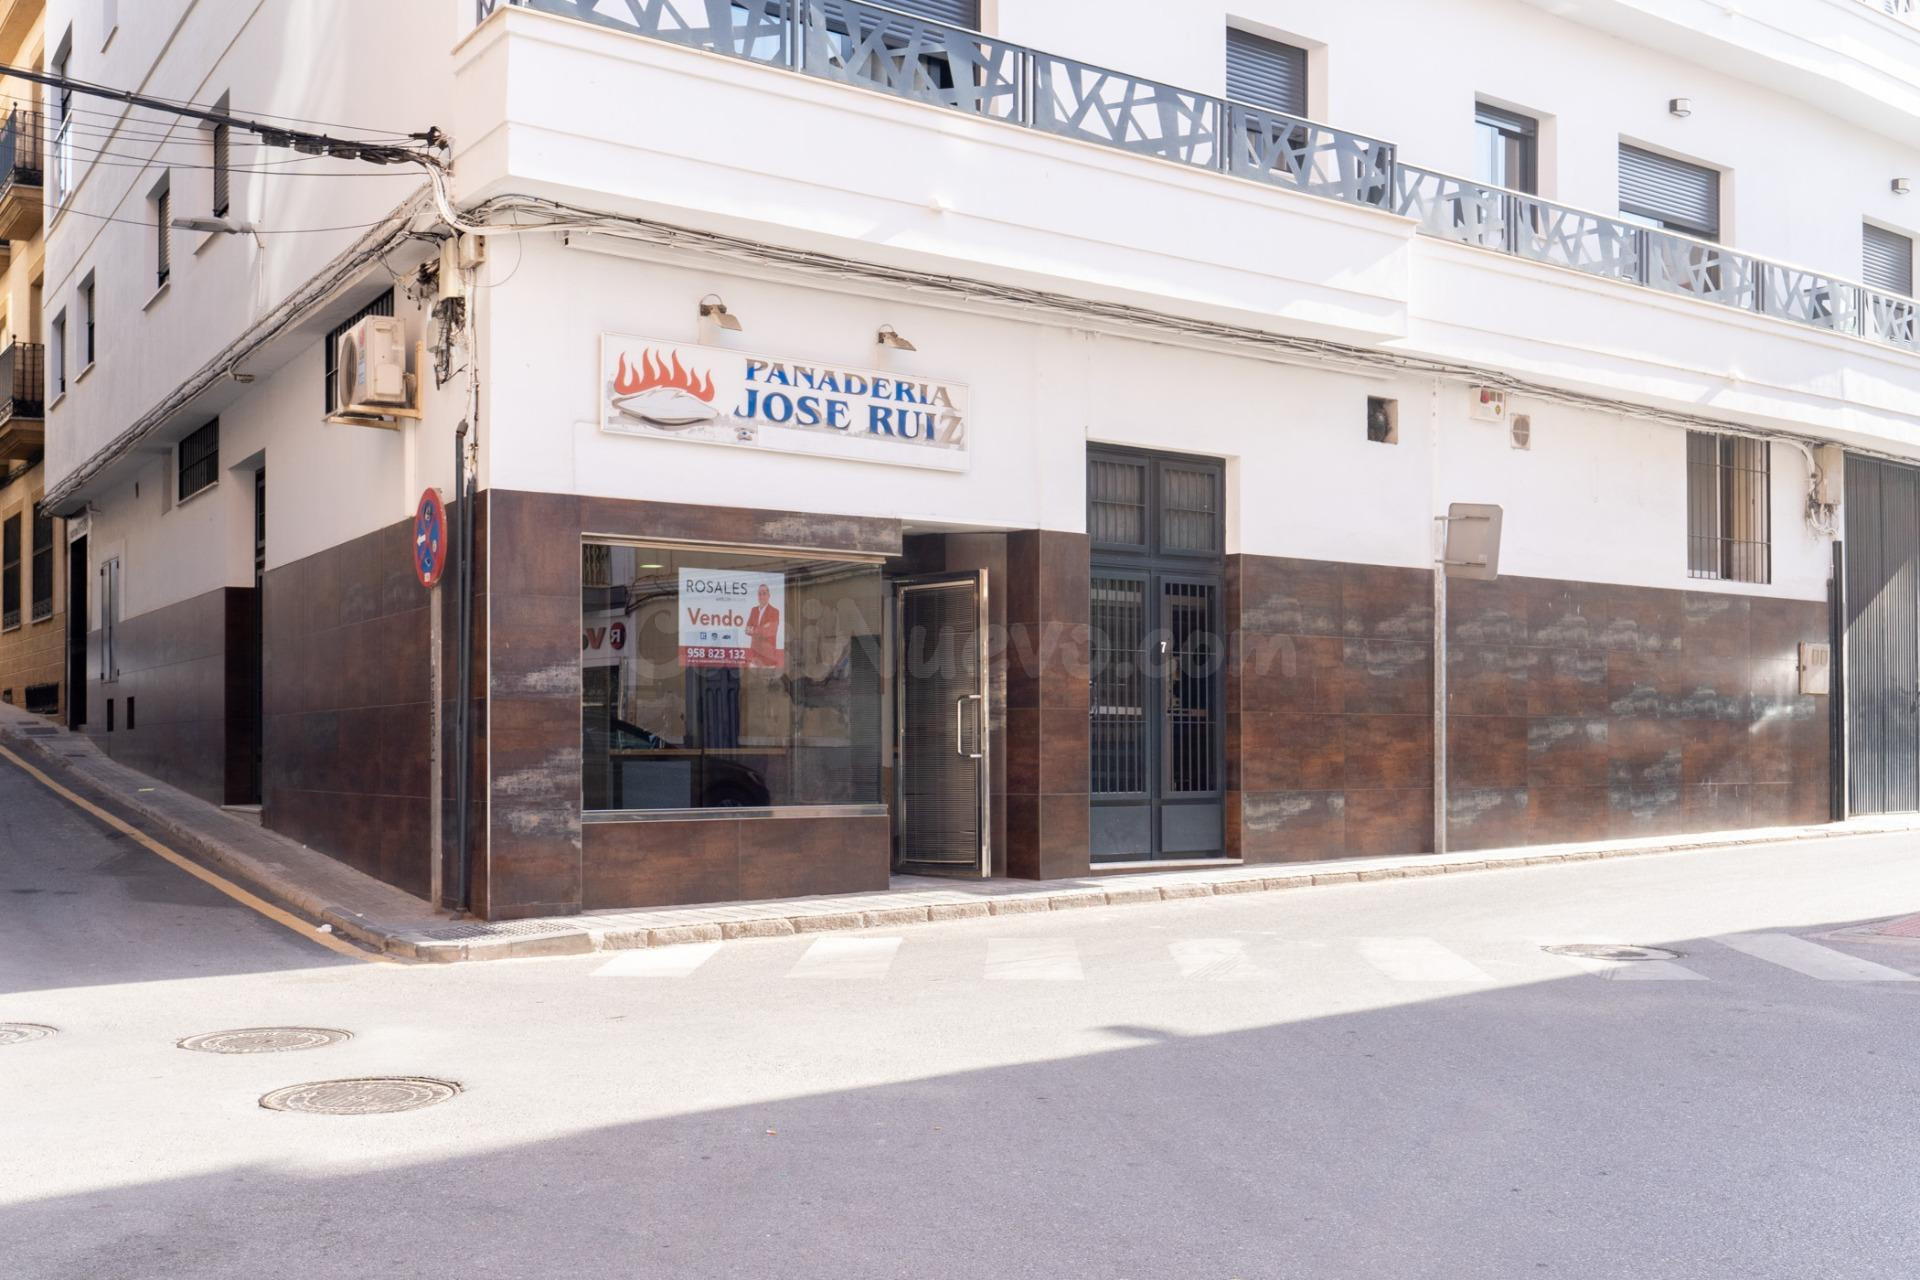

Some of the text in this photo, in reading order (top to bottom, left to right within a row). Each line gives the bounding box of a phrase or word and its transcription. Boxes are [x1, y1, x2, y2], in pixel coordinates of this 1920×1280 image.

[745, 358, 960, 411] PANADERIA
[733, 388, 965, 445] JOSE RUIZ
[686, 579, 748, 595] ROSALES
[687, 607, 744, 627] Vendo
[687, 648, 746, 659] 958 823 132
[1160, 641, 1167, 653] 7
